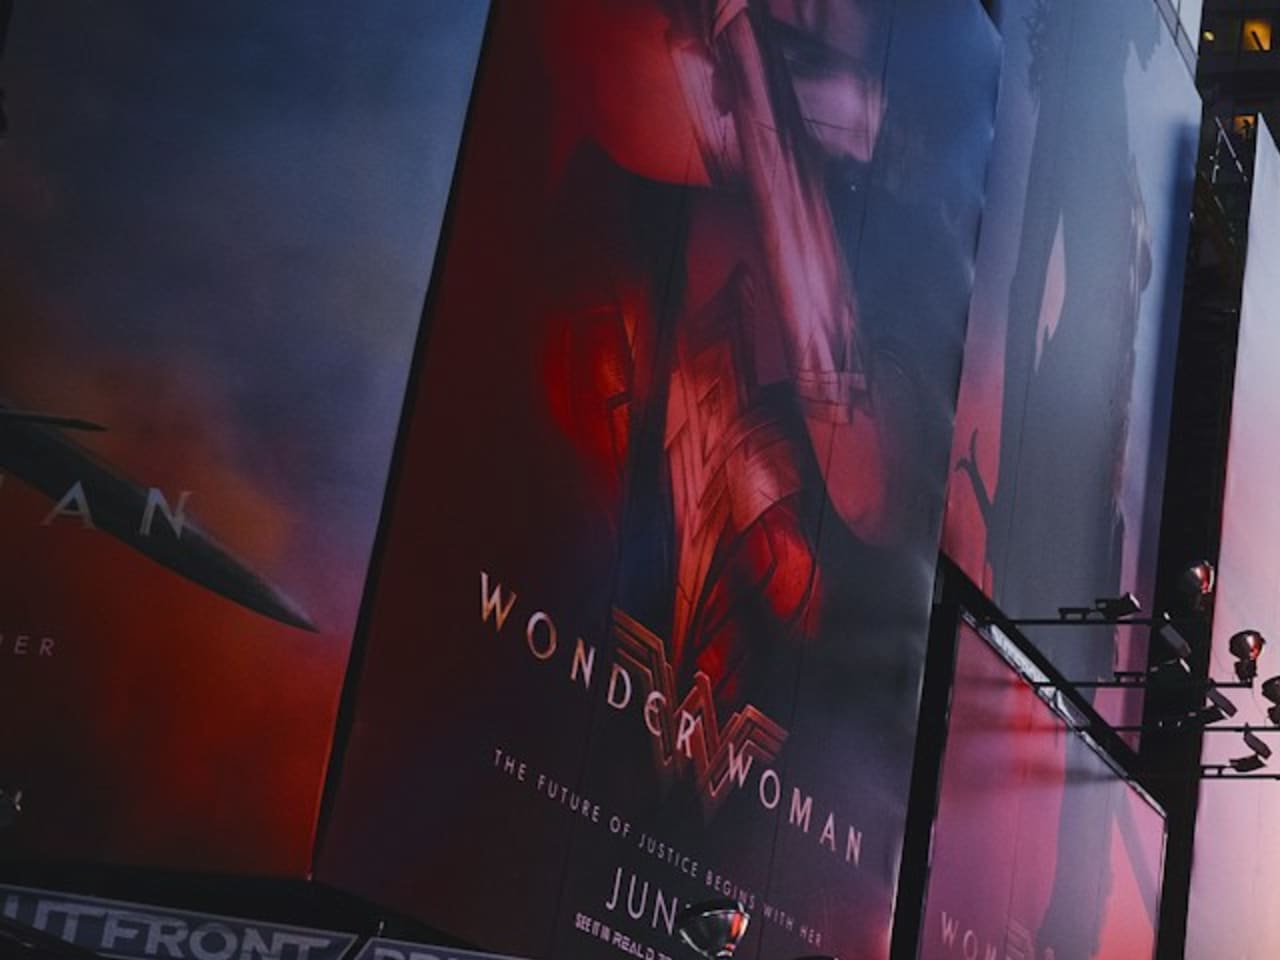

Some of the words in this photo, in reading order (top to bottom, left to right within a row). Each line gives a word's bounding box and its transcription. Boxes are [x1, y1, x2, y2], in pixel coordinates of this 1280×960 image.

[0, 474, 192, 541] AN
[479, 570, 704, 759] WONDER
[726, 741, 863, 867] WOMAN
[493, 748, 527, 783] THE
[536, 773, 601, 825] FUTURE
[609, 815, 632, 839] OF
[637, 832, 699, 879] JUSTICE
[705, 869, 756, 911] BEGINS
[763, 902, 795, 932] WITH
[800, 924, 823, 948] HER
[605, 866, 680, 938] JUN
